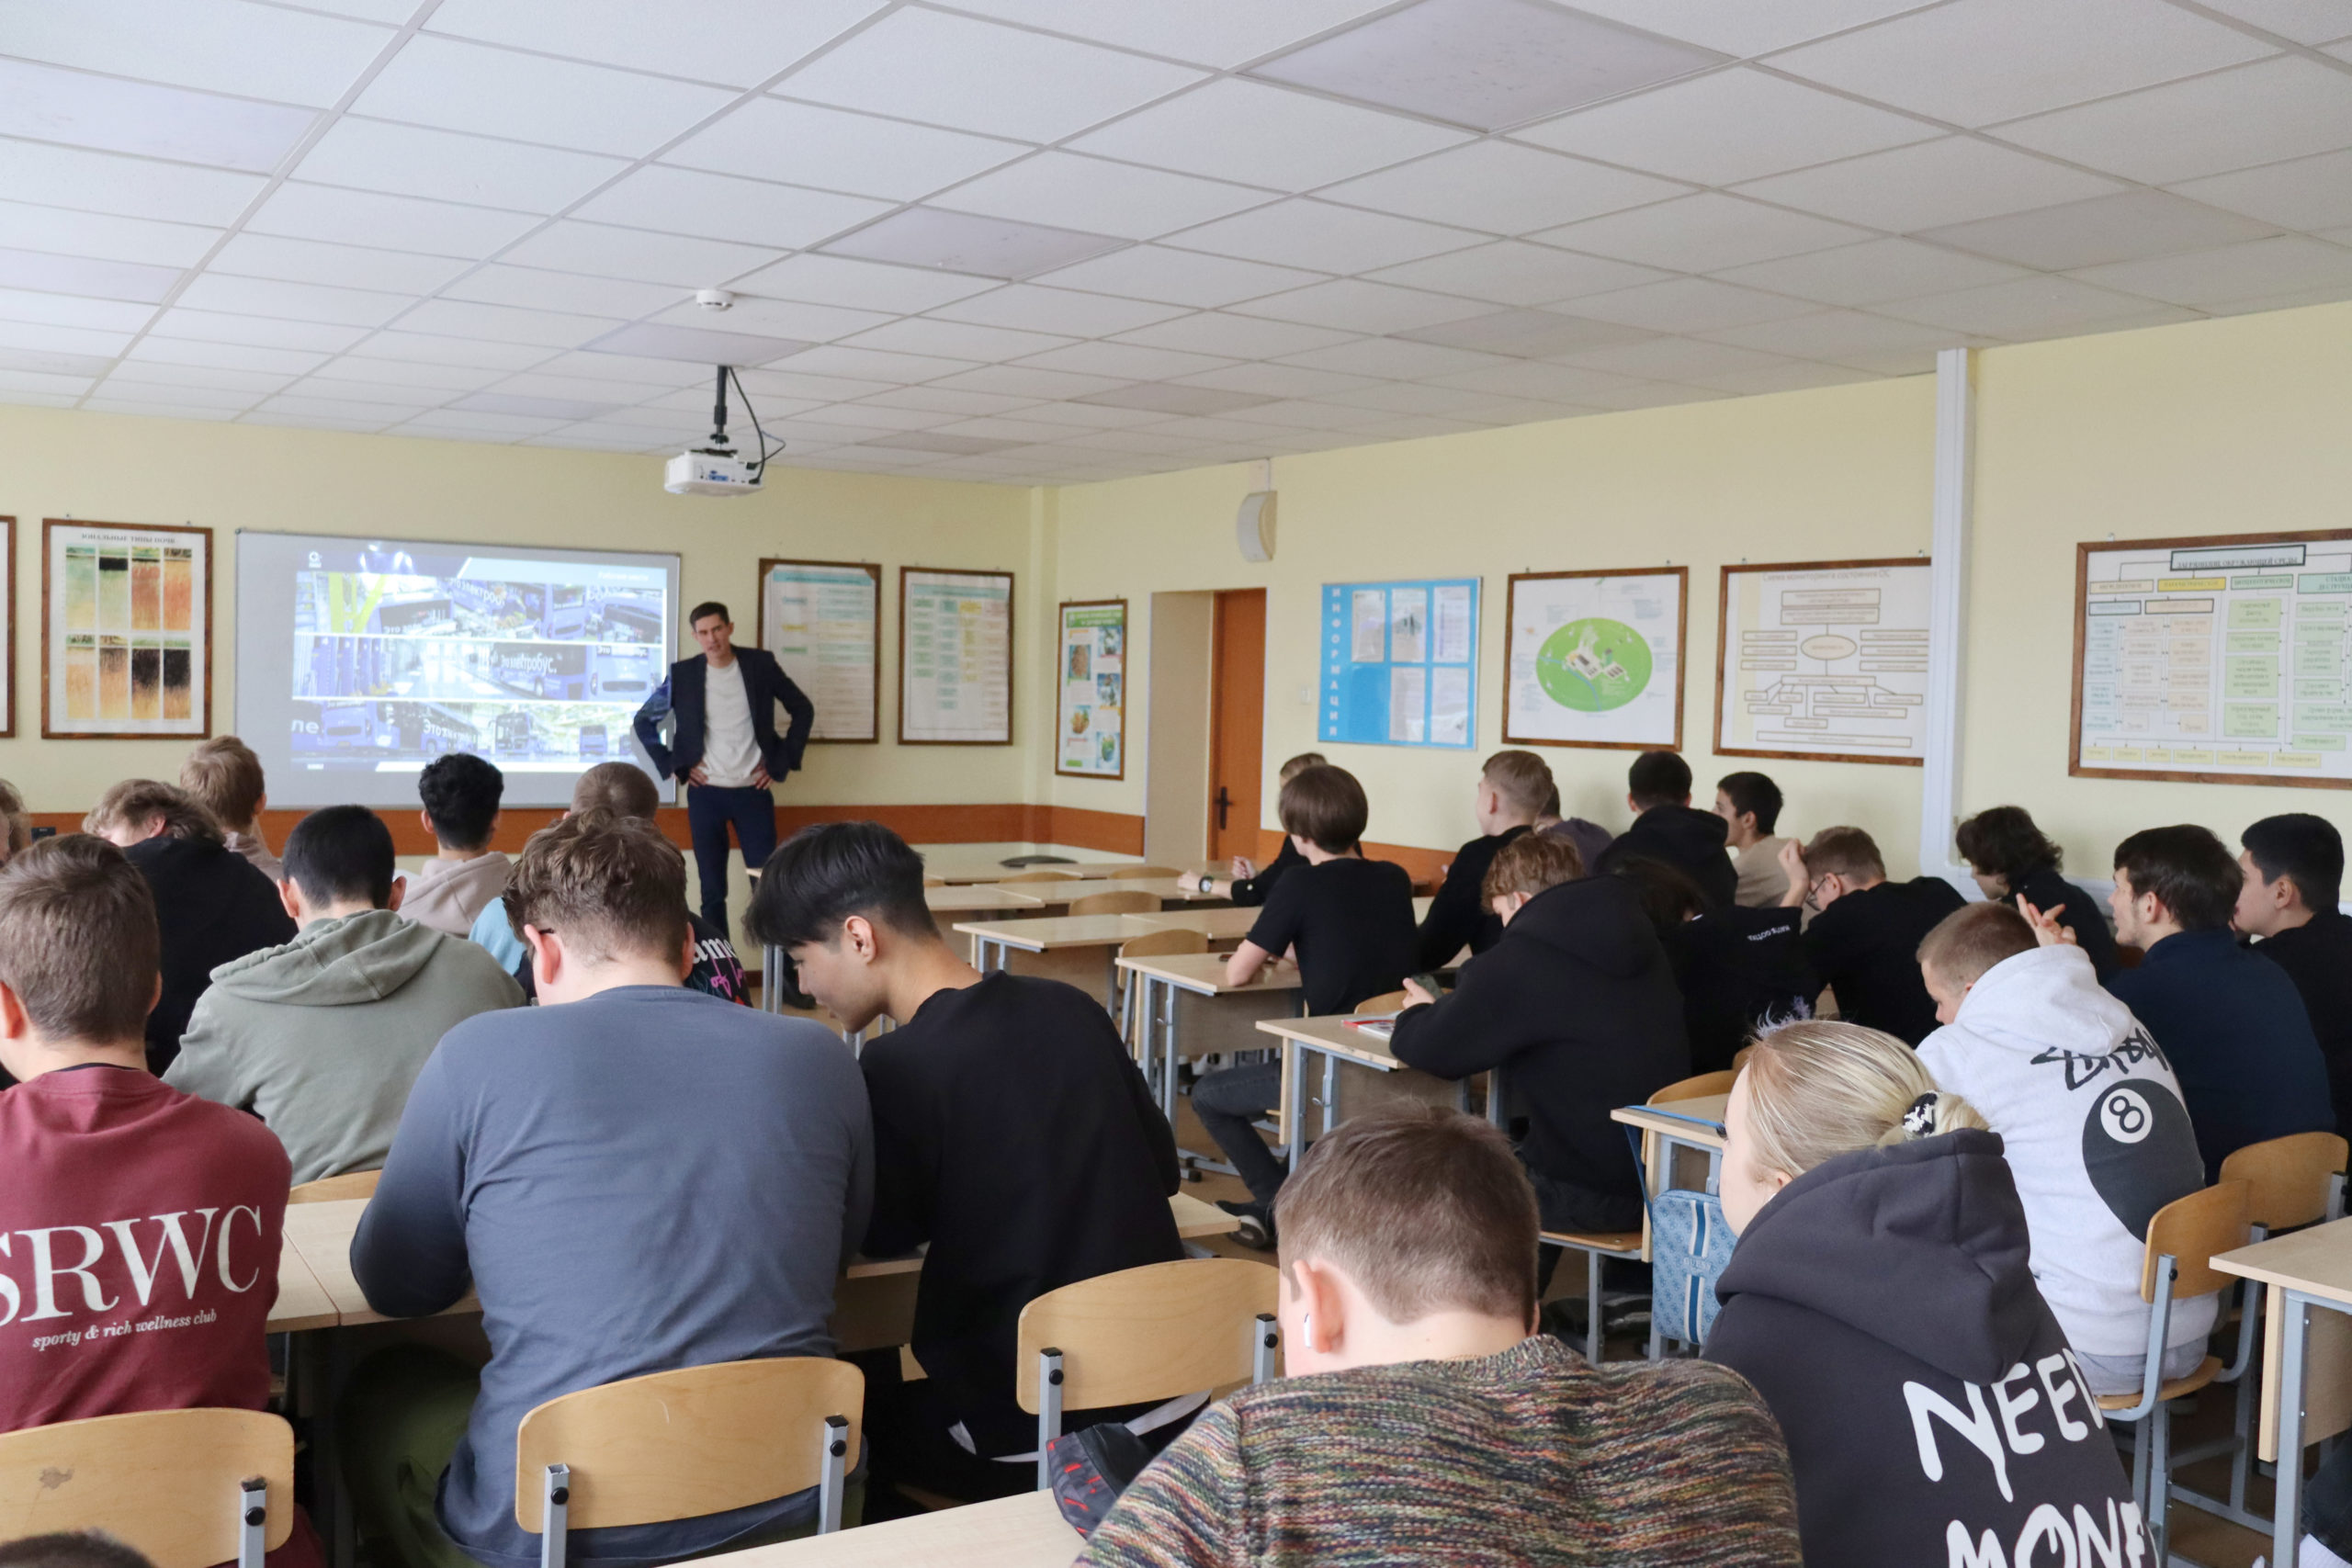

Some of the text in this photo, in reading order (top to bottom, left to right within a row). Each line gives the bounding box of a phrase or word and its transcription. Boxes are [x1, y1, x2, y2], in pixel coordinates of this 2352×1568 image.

[2109, 1095, 2145, 1134] 8
[33, 1308, 217, 1351] sporty & rich wellness club
